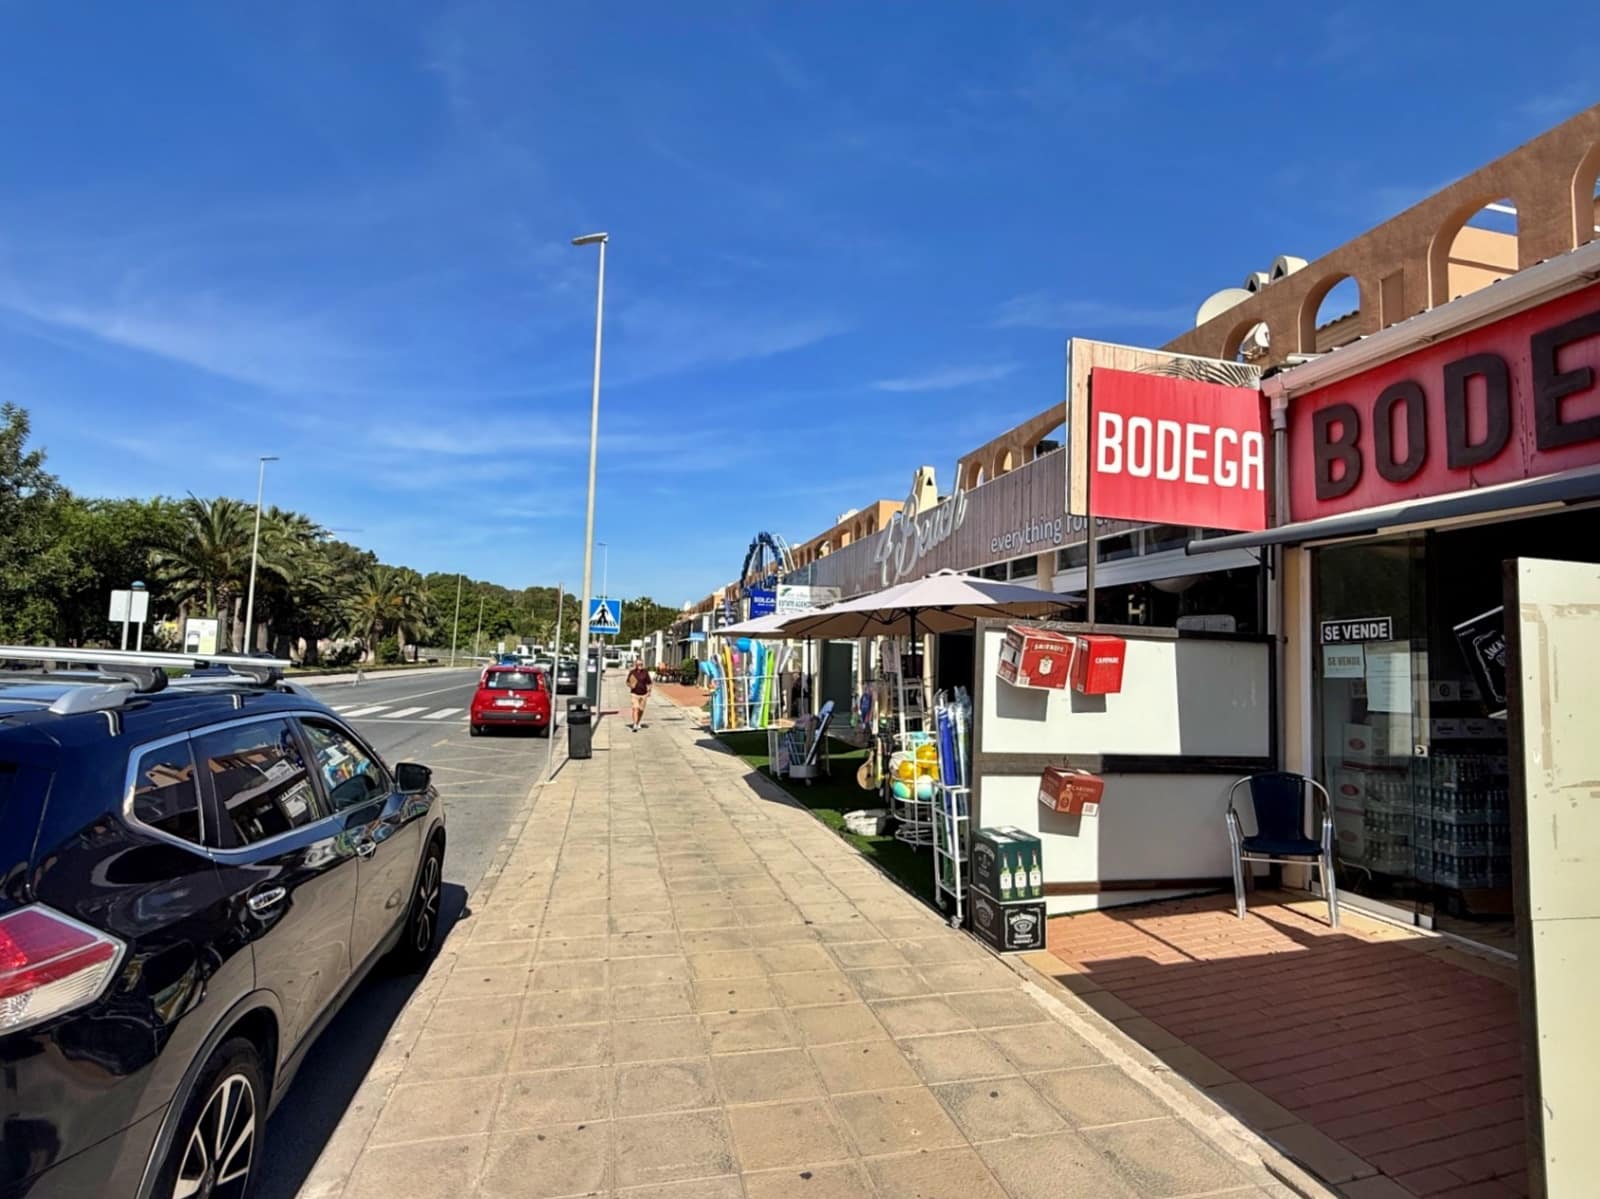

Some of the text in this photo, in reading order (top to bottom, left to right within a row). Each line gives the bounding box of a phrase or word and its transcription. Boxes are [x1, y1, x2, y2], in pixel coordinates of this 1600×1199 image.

[1096, 411, 1265, 491] BODEGA
[991, 516, 1062, 552] everything
[1325, 623, 1387, 640] SE VENDE
